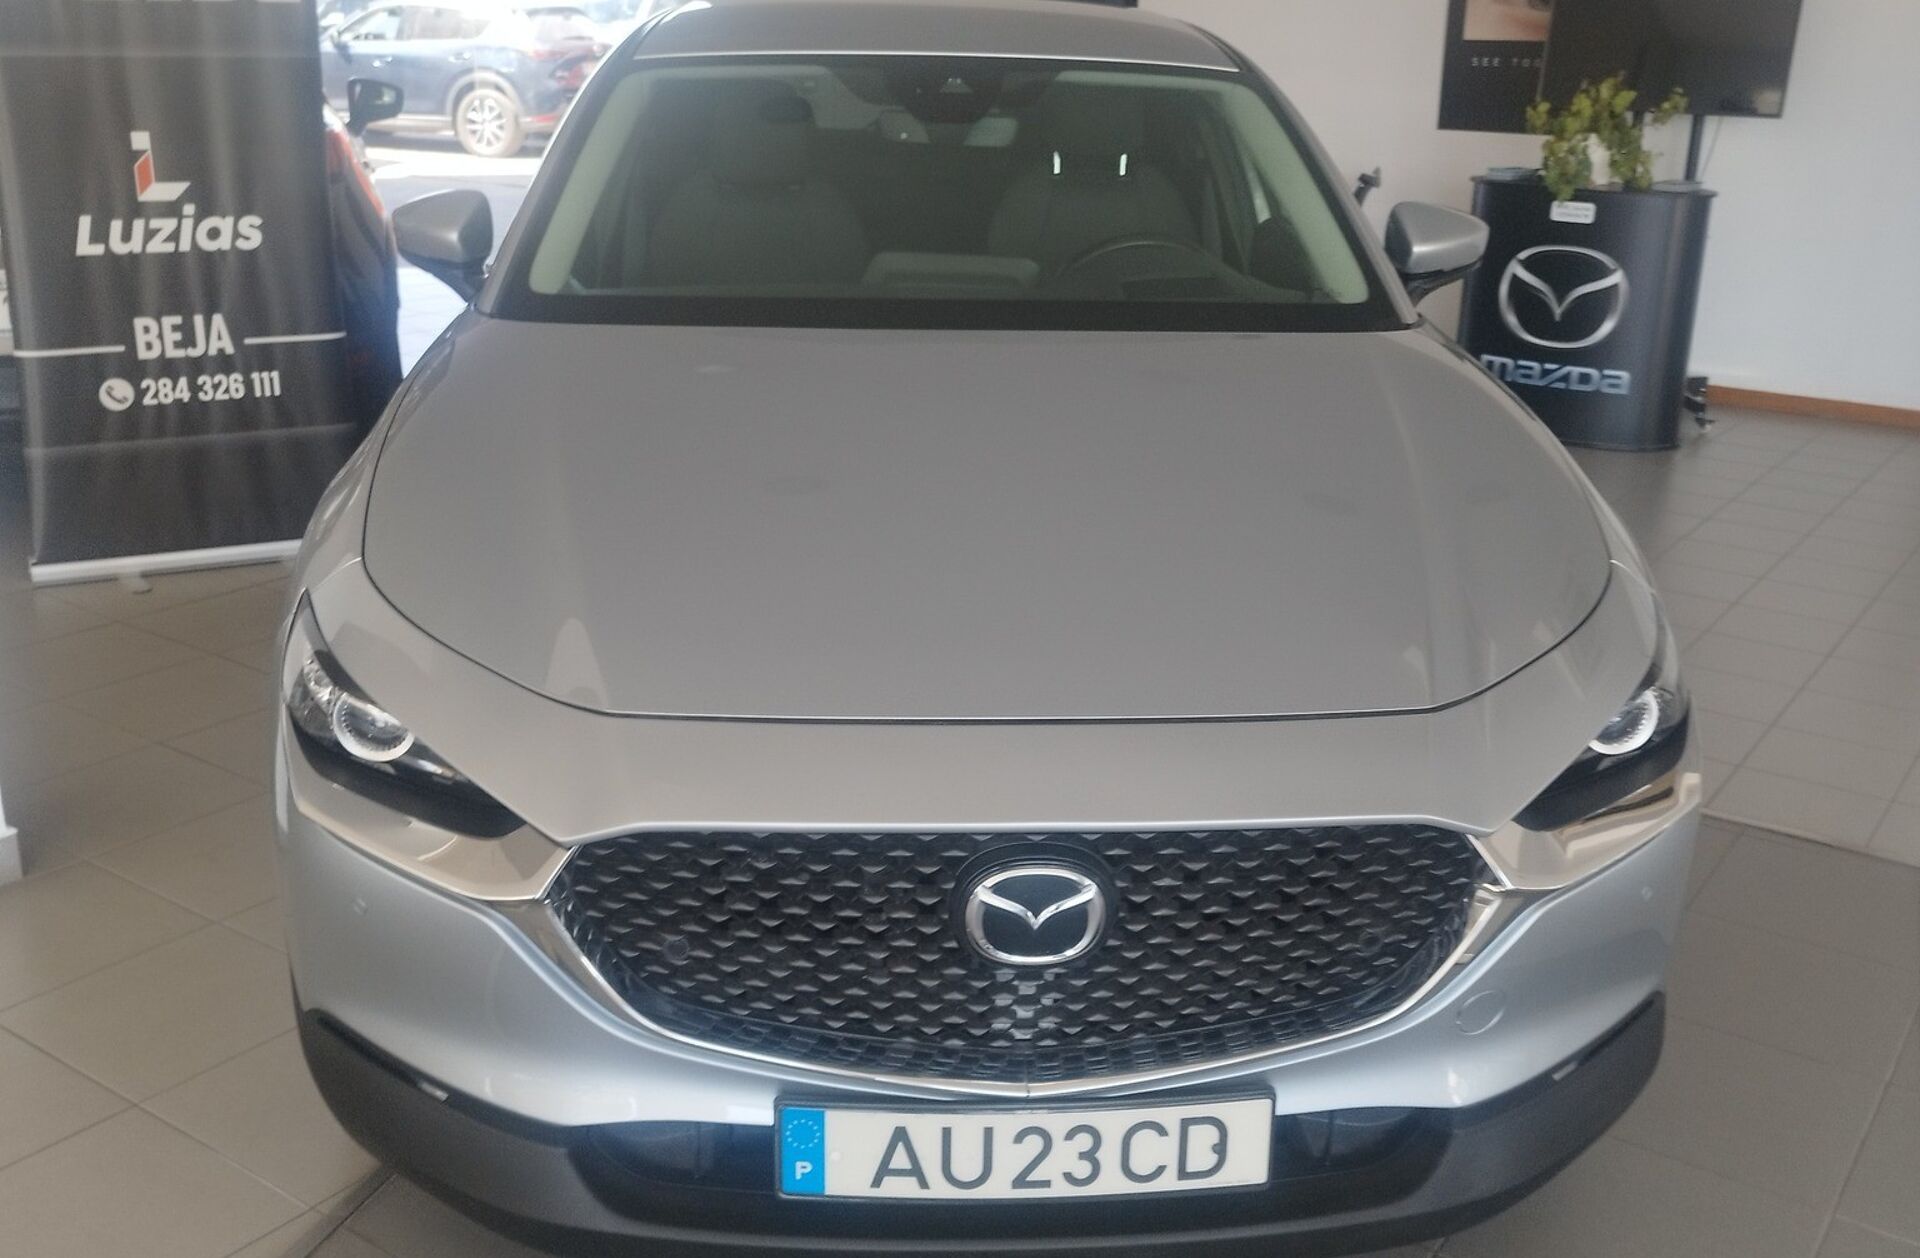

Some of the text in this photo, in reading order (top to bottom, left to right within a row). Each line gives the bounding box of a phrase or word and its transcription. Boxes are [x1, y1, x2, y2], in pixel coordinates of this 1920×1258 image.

[1471, 57, 1500, 67] SEE
[75, 203, 263, 256] Luzias
[133, 313, 235, 361] BEJA
[140, 370, 281, 405] 284 326 111
[795, 1161, 813, 1181] P
